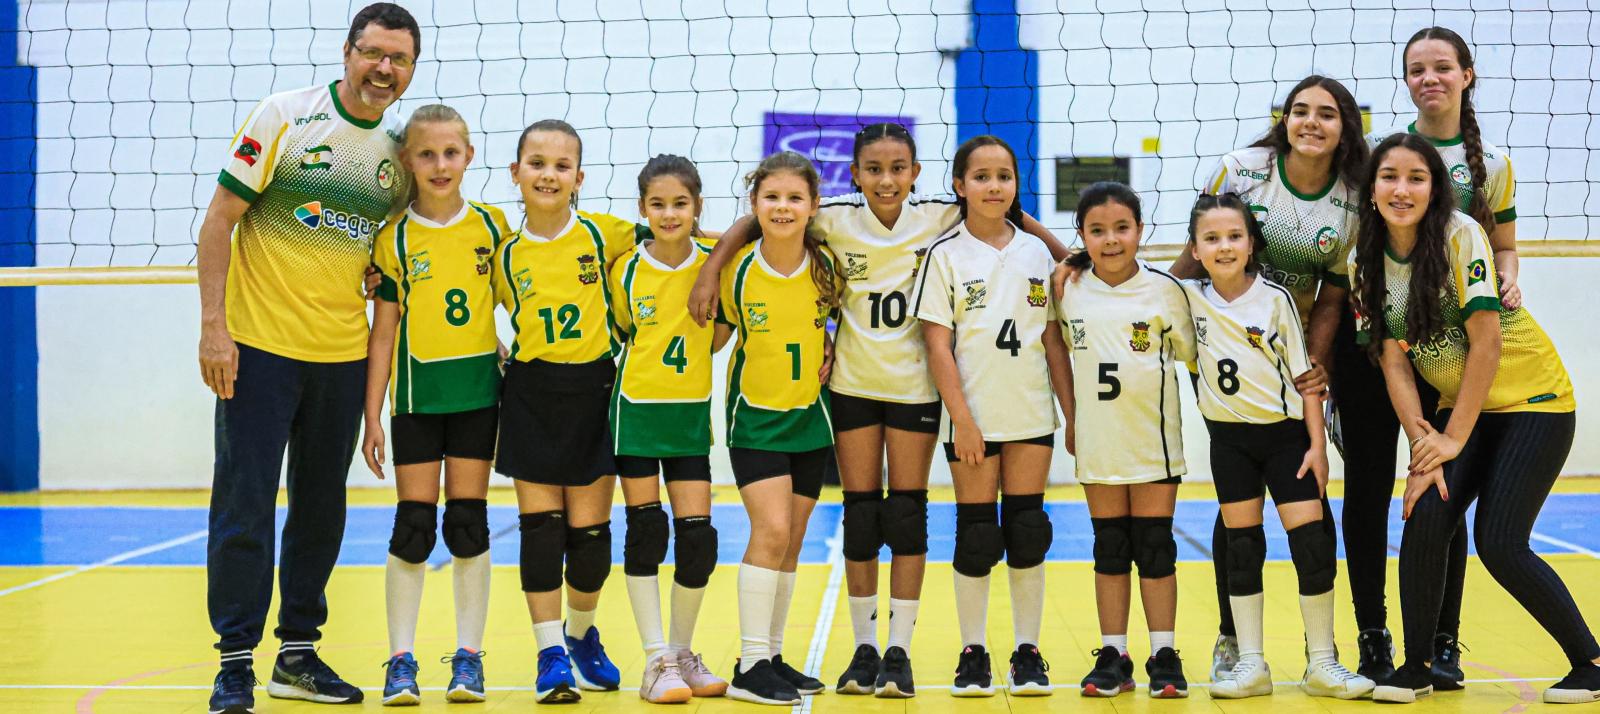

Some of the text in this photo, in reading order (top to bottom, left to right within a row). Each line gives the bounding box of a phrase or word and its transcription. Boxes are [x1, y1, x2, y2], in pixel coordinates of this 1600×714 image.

[445, 288, 470, 326] 8
[538, 303, 582, 344] 12
[868, 290, 907, 328] 10
[662, 336, 687, 374] 4
[995, 318, 1021, 357] 4
[786, 343, 801, 380] 1
[1217, 358, 1240, 396] 8
[1098, 363, 1121, 401] 5
